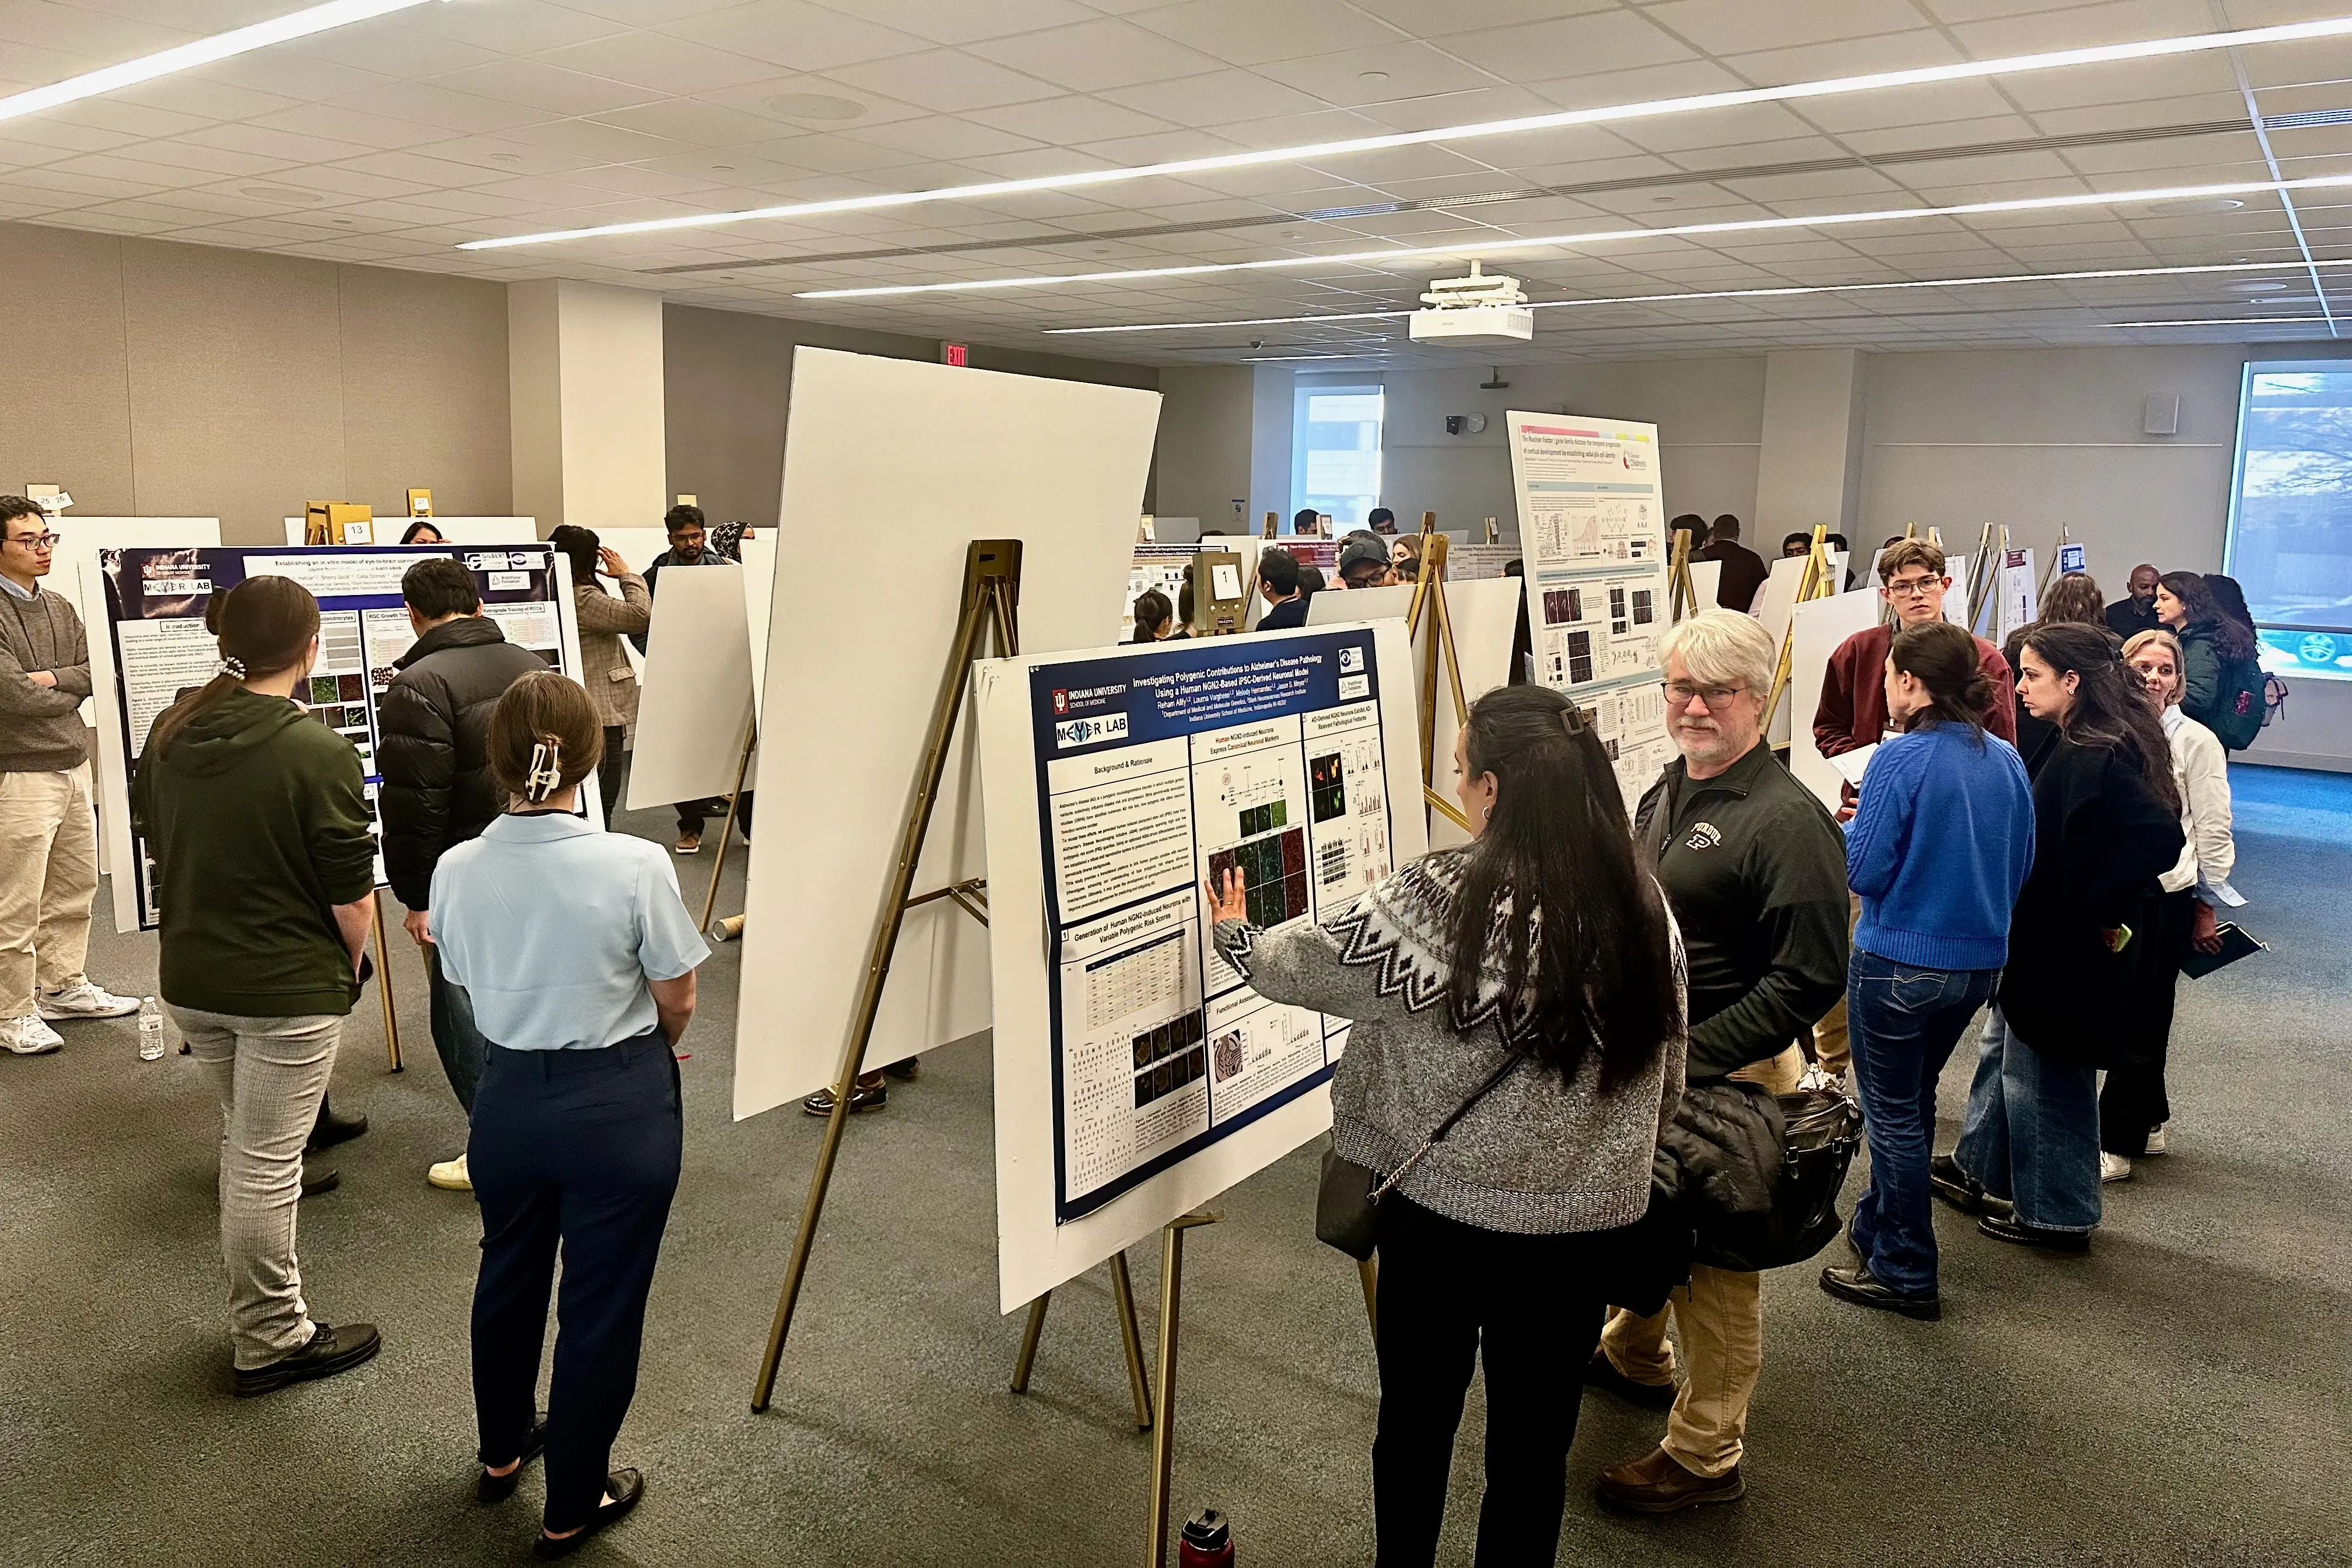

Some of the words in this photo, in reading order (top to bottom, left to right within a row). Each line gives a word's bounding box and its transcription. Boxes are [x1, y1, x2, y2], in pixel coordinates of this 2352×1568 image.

[948, 345, 965, 366] EXIT
[351, 526, 363, 534] 13
[1222, 570, 1227, 583] 1
[1133, 674, 1174, 688] Investigating
[1175, 670, 1206, 682] Polygenic
[1206, 666, 1243, 678] Contributions
[1244, 664, 1250, 672] to
[1251, 660, 1280, 671] Alzheimer's
[1280, 656, 1299, 667] Disease
[1299, 654, 1322, 664] Pathology
[1155, 688, 1174, 699] Using
[1180, 684, 1202, 695] Human
[1202, 678, 1238, 691] NGN2-Based
[1238, 672, 1272, 686] iPSC-Derived
[1272, 669, 1294, 681] Neuronal
[1294, 667, 1309, 677] Model
[1068, 688, 1093, 700] INDIANA
[1094, 684, 1126, 697] UNIVERSITY
[1069, 701, 1084, 709] SCHOOL
[1057, 722, 1101, 742] MEYER
[1107, 718, 1126, 733] LAB
[1210, 746, 1227, 755] Express
[1094, 762, 1124, 774] Background
[1130, 757, 1153, 767] Rationale
[1686, 834, 1711, 848] P
[1690, 822, 1721, 844] PURDUE
[1074, 926, 1103, 942] Generation
[1104, 923, 1109, 932] of
[1110, 918, 1128, 930] Human
[1128, 906, 1162, 923] NGN2-Induced
[1163, 899, 1182, 912] Neurons
[1182, 895, 1191, 904] with
[1099, 932, 1119, 943] Variable
[1119, 922, 1143, 935] Polygenic
[1144, 916, 1155, 928] Risk
[1156, 912, 1171, 923] Scores
[1216, 1000, 1238, 1016] Functional
